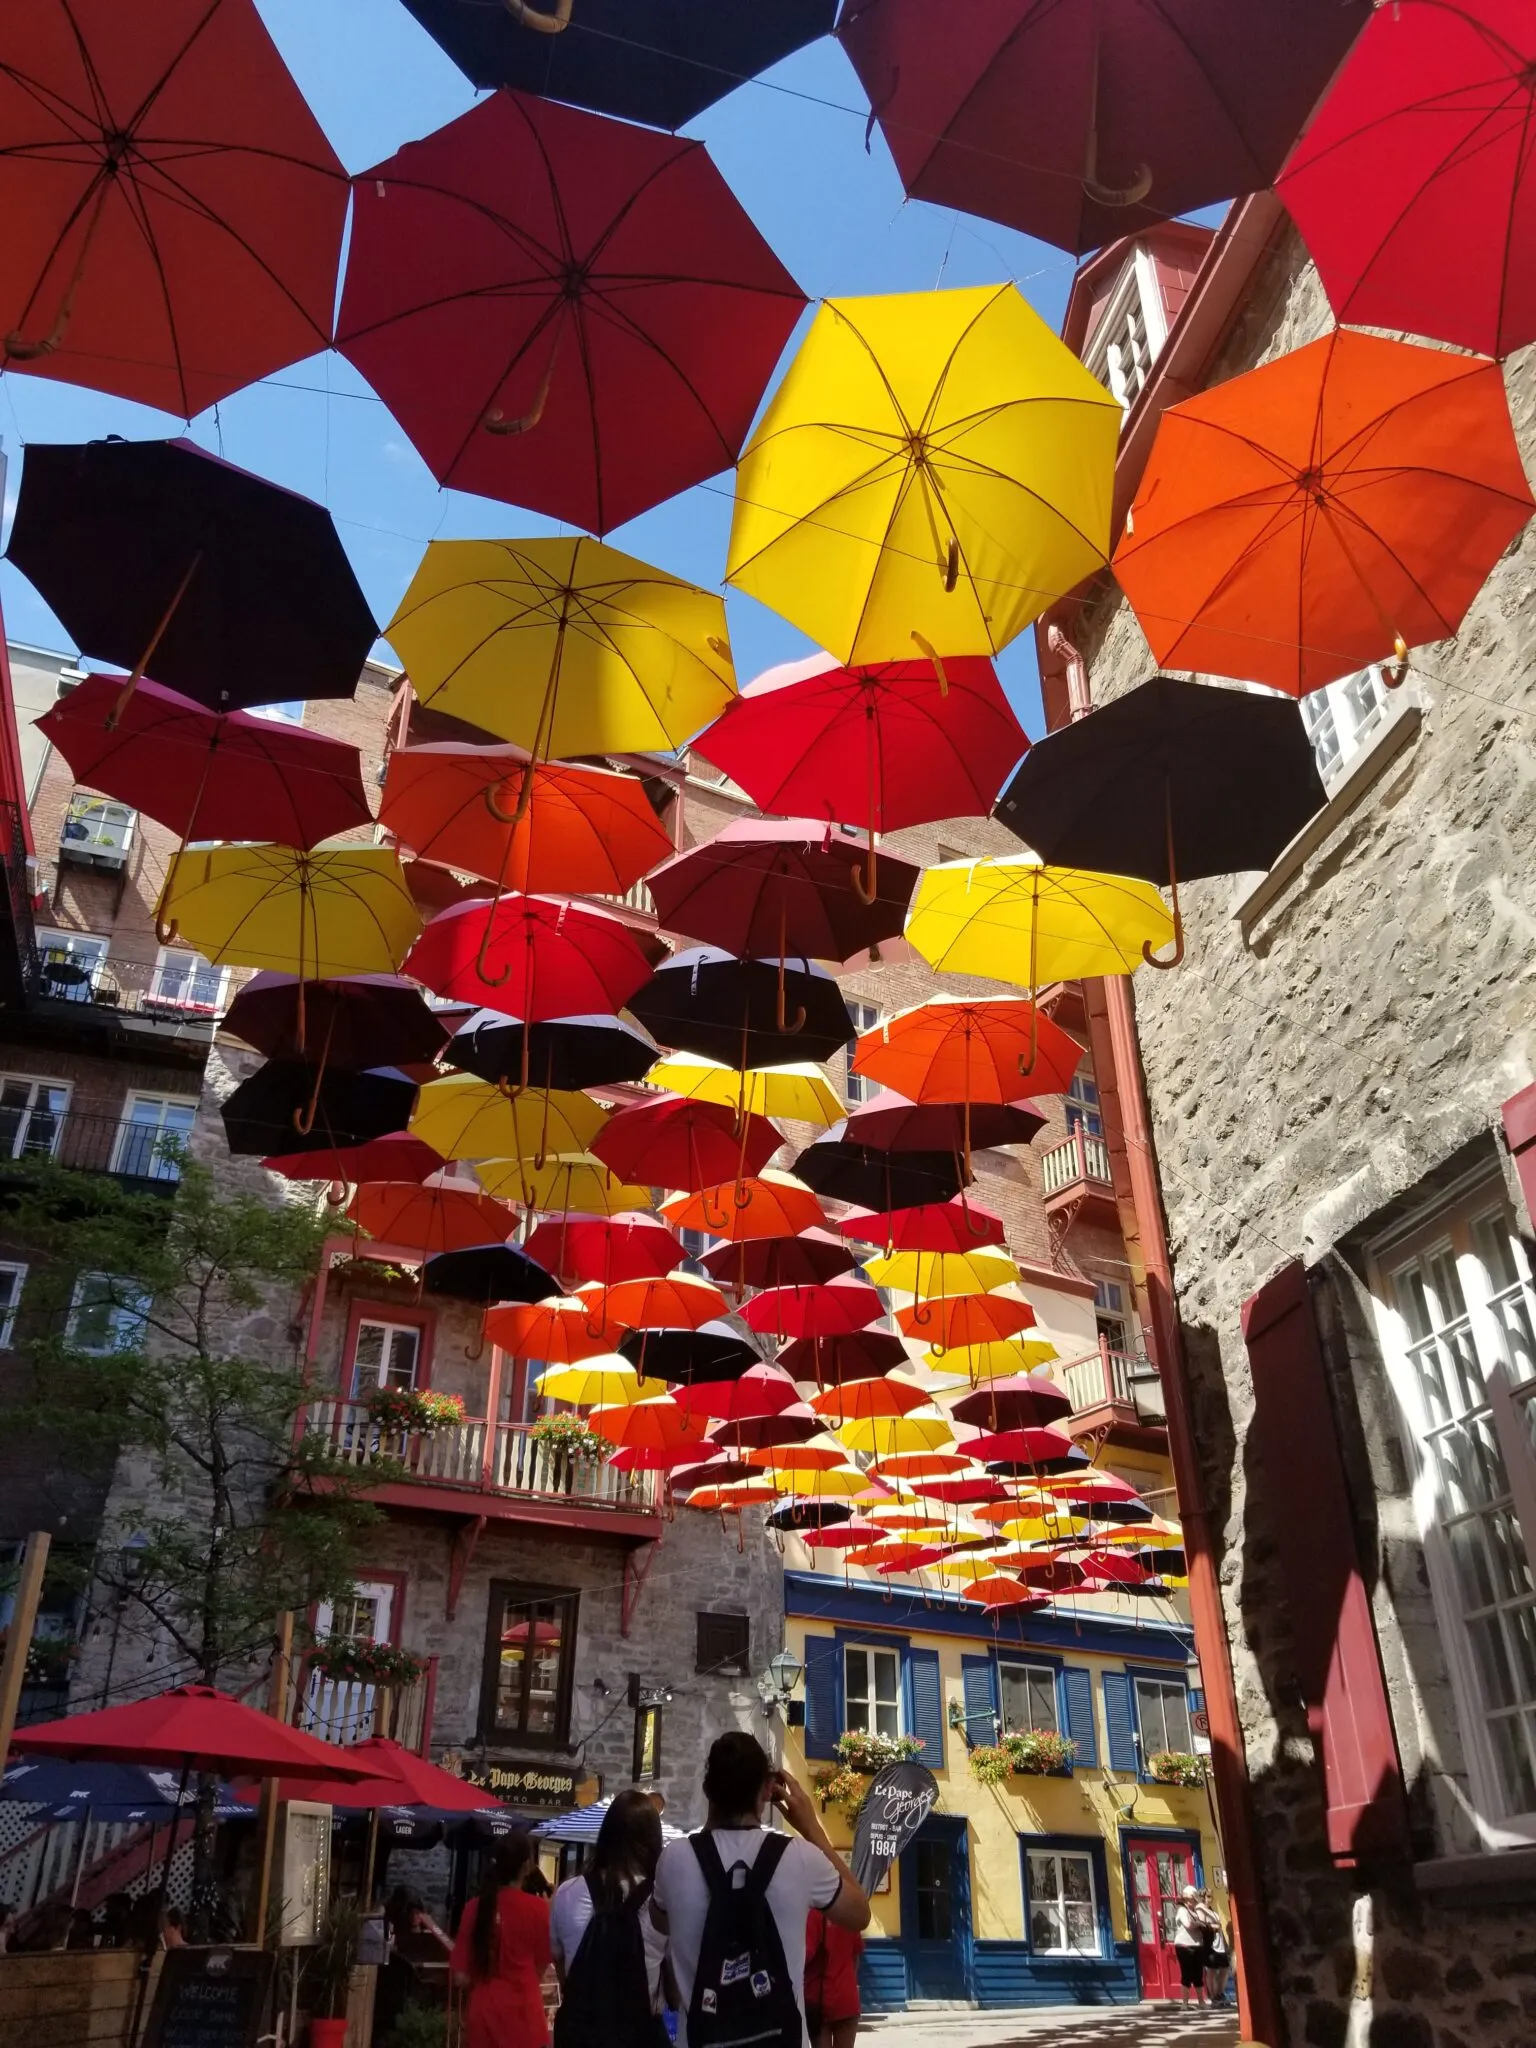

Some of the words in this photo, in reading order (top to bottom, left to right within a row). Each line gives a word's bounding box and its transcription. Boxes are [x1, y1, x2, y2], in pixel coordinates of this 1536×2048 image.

[874, 1785, 887, 1796] Le
[888, 1786, 913, 1801] Pape
[539, 1798, 561, 1806] BAR
[883, 1788, 935, 1829] Georges
[395, 1826, 412, 1835] LAGER
[870, 1840, 897, 1858] 1984
